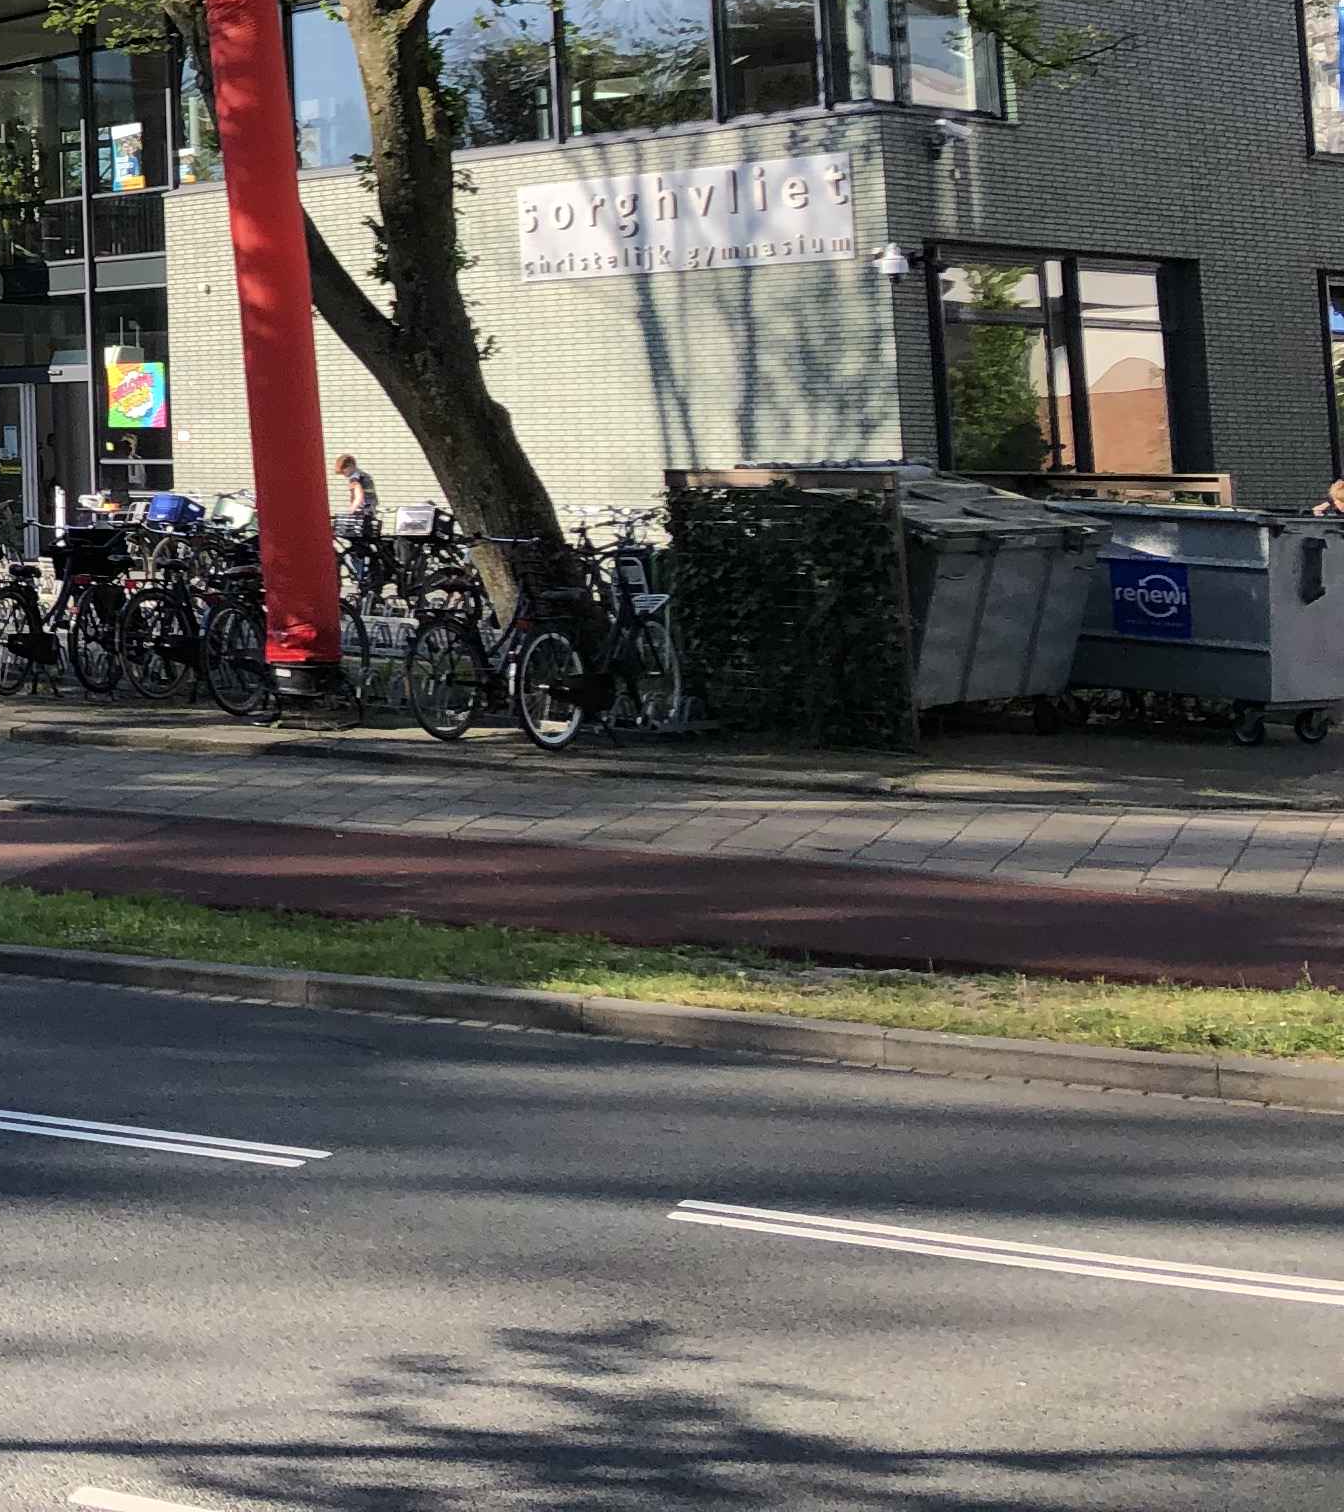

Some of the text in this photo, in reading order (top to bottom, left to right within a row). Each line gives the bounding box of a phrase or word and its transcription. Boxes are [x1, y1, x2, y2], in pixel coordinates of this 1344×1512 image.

[522, 163, 849, 239] sorghvliet
[523, 234, 852, 276] christelijk gymnasium
[1114, 586, 1187, 606] renewi
